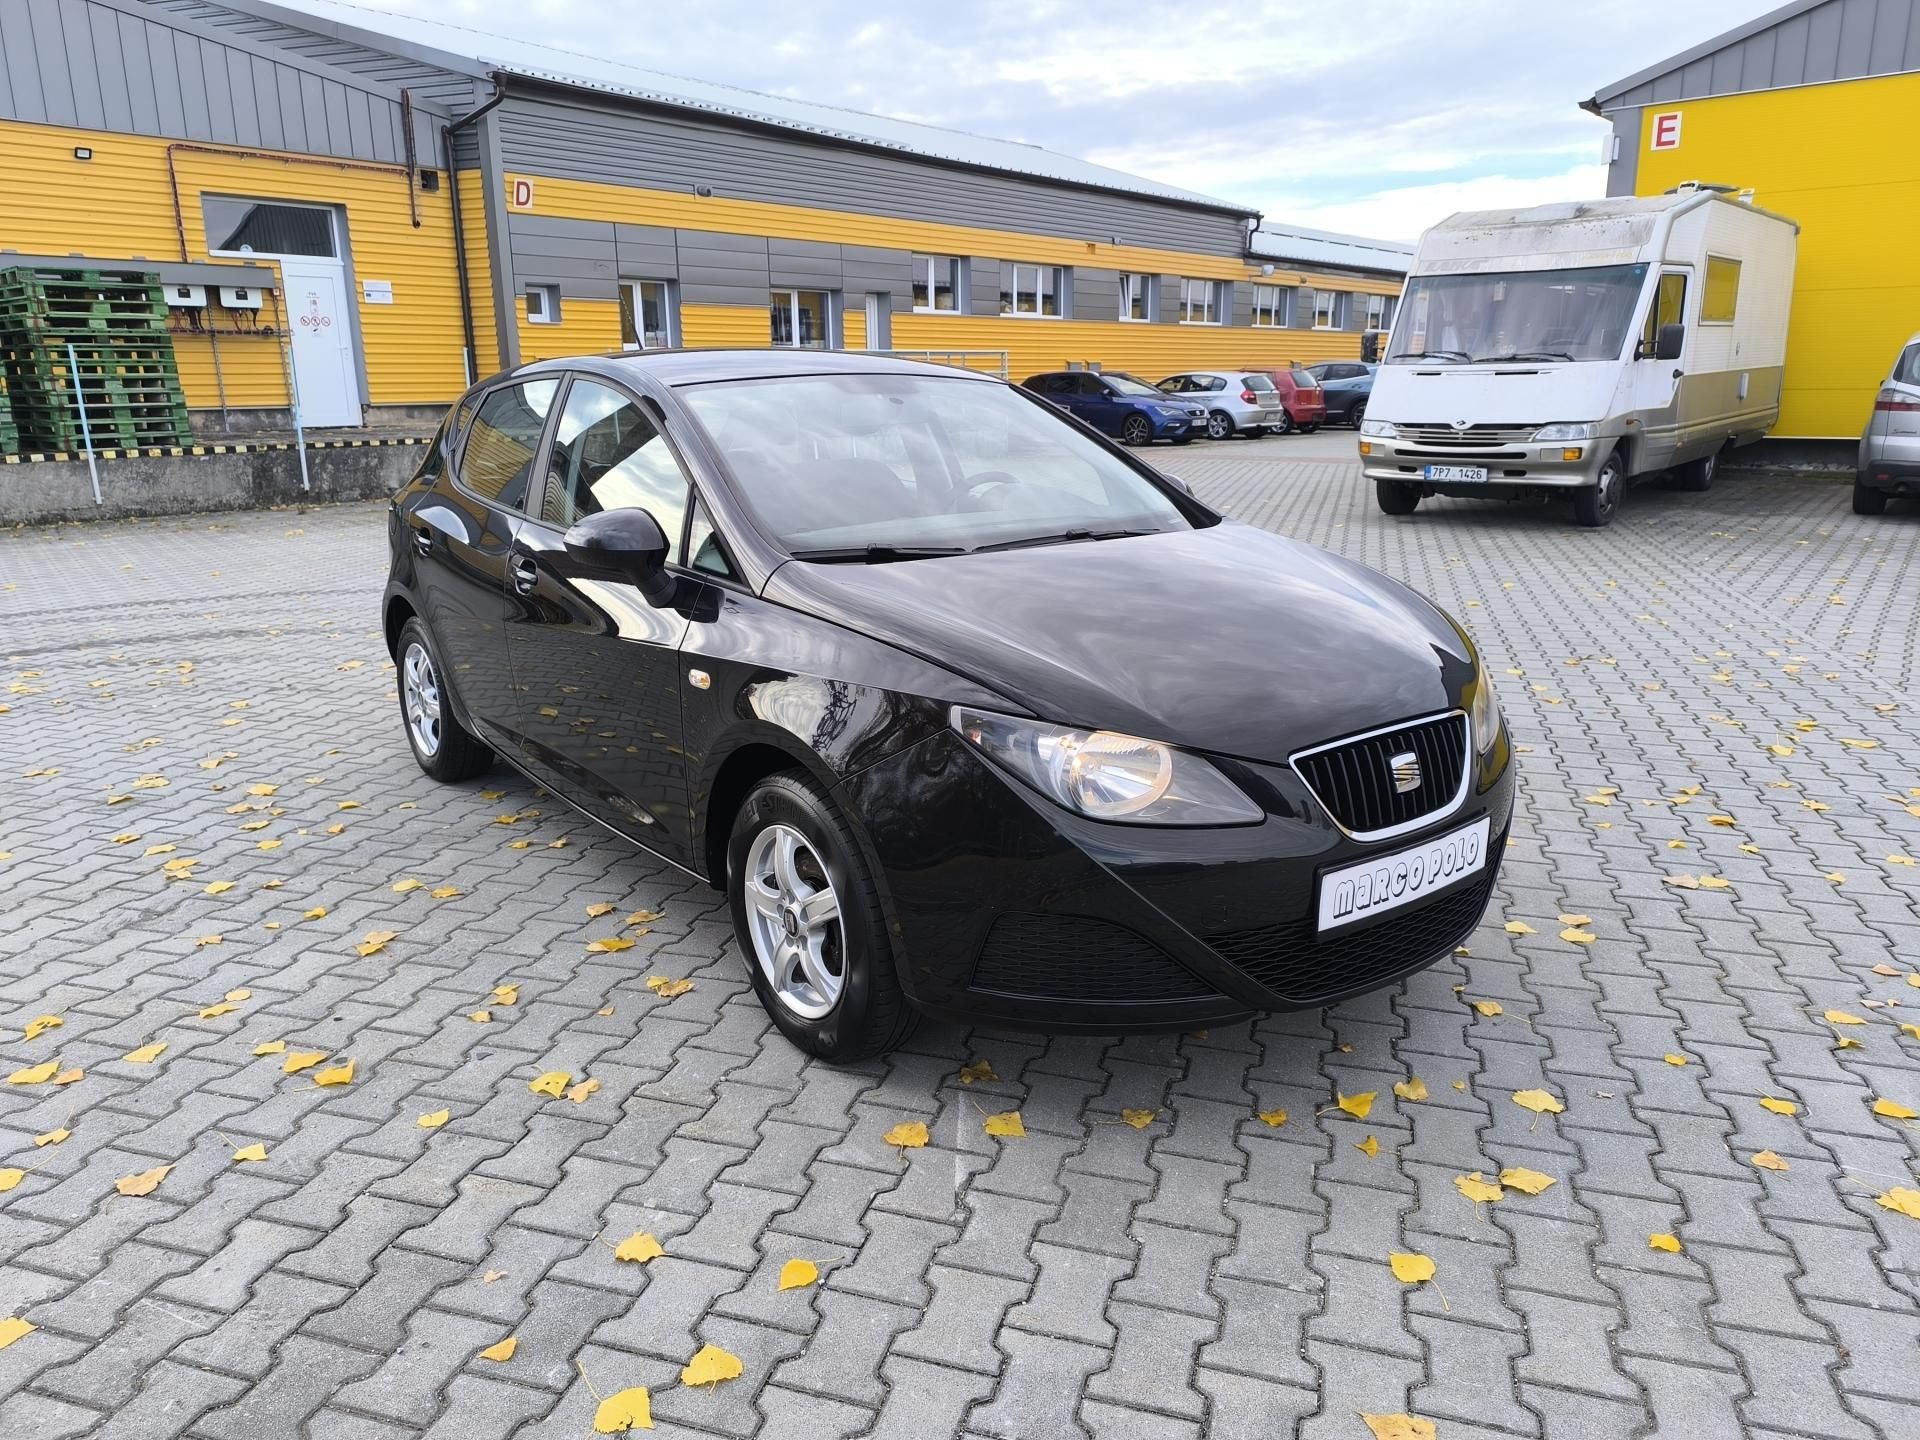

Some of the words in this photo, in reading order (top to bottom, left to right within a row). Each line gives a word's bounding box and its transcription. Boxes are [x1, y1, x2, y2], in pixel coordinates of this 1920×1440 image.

[1656, 114, 1678, 147] E
[516, 181, 531, 206] D
[1432, 467, 1451, 478] 7P7
[1459, 469, 1482, 480] 1426
[1428, 833, 1480, 885] POLO
